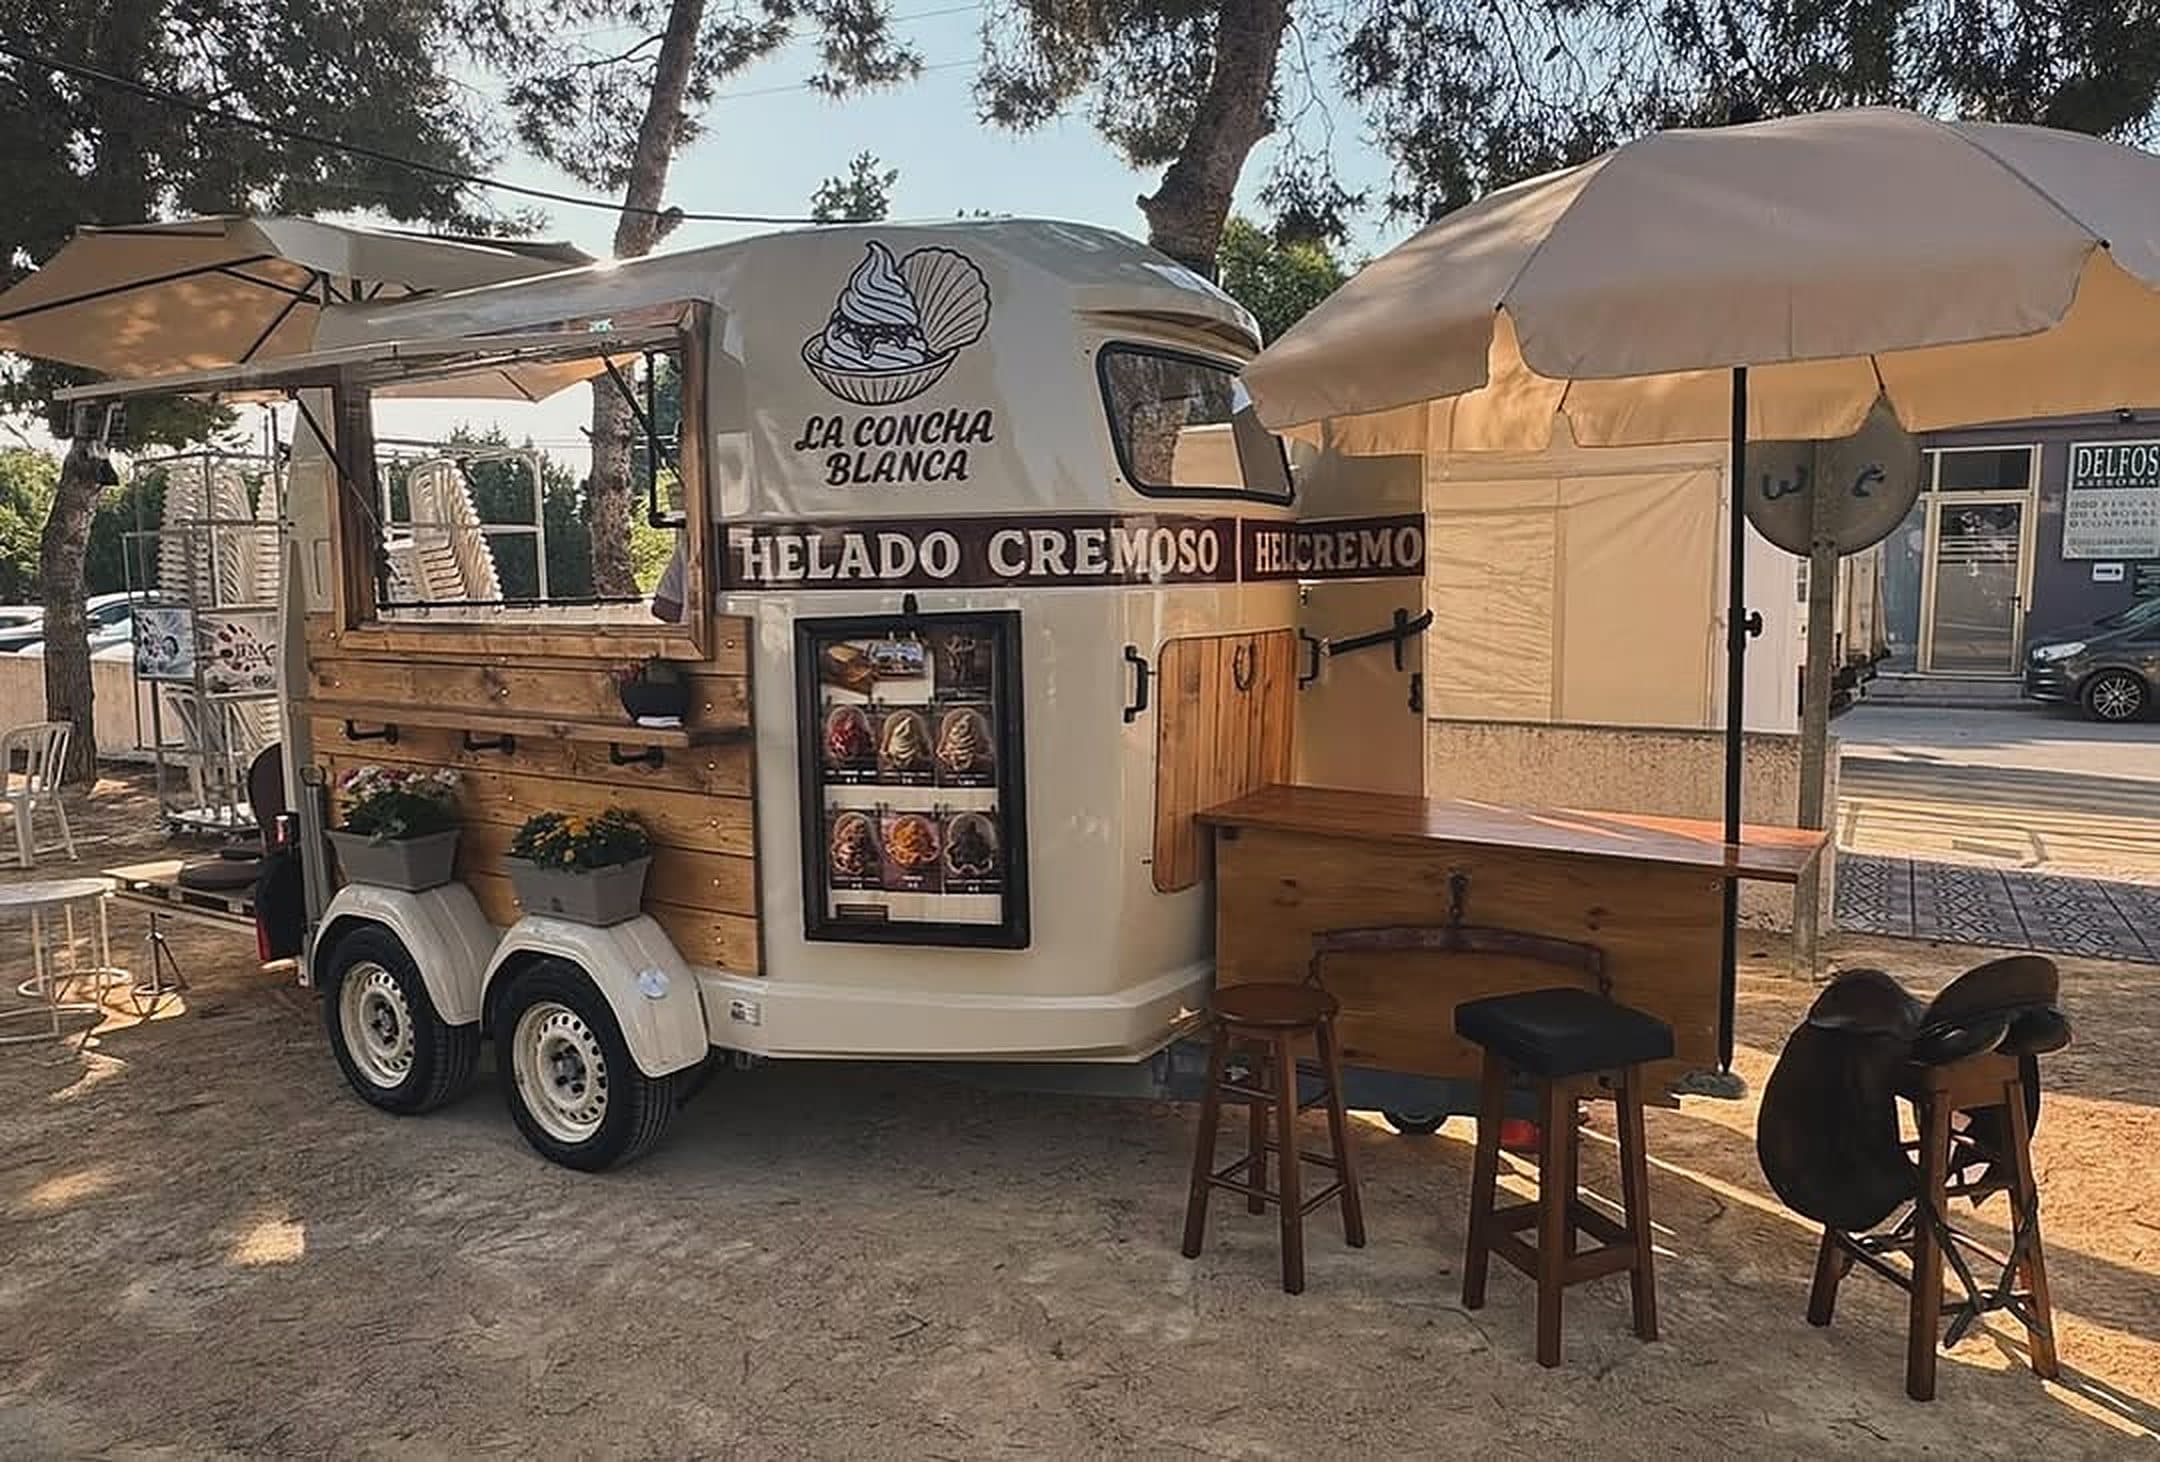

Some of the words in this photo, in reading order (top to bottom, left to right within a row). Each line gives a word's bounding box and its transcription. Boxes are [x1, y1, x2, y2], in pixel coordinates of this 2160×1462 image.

[794, 415, 845, 451] LA
[853, 408, 994, 448] CONCHA
[825, 449, 969, 486] BLANCA
[2077, 446, 2159, 478] DELFOS
[741, 530, 960, 581] HELADO
[988, 528, 1220, 577] CREMOSO
